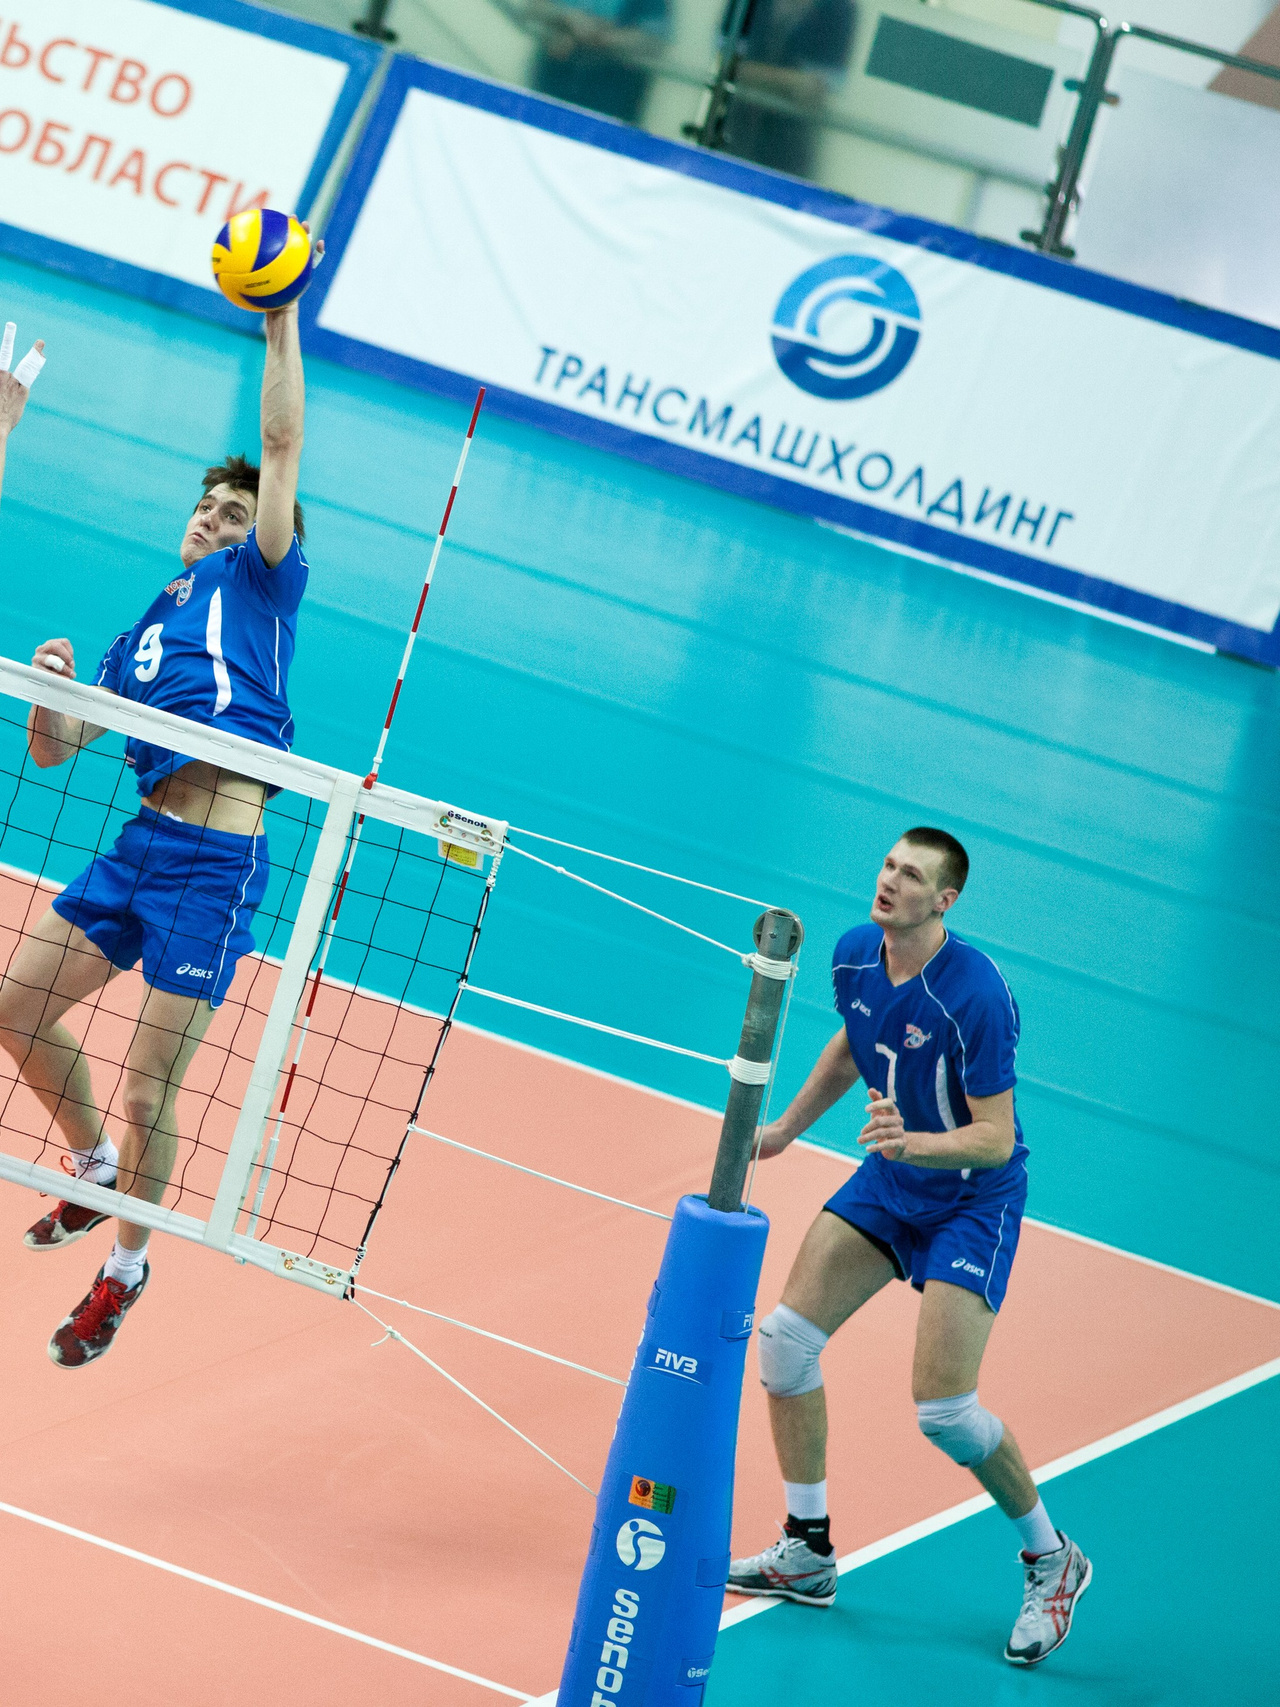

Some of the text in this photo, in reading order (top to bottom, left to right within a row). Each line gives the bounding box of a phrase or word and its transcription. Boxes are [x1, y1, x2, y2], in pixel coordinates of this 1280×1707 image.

[534, 345, 1075, 548] ТРАНСМАШХОЛДИНГ
[134, 622, 164, 682] 9
[454, 812, 488, 829] Senoh
[654, 1347, 699, 1375] FIVB
